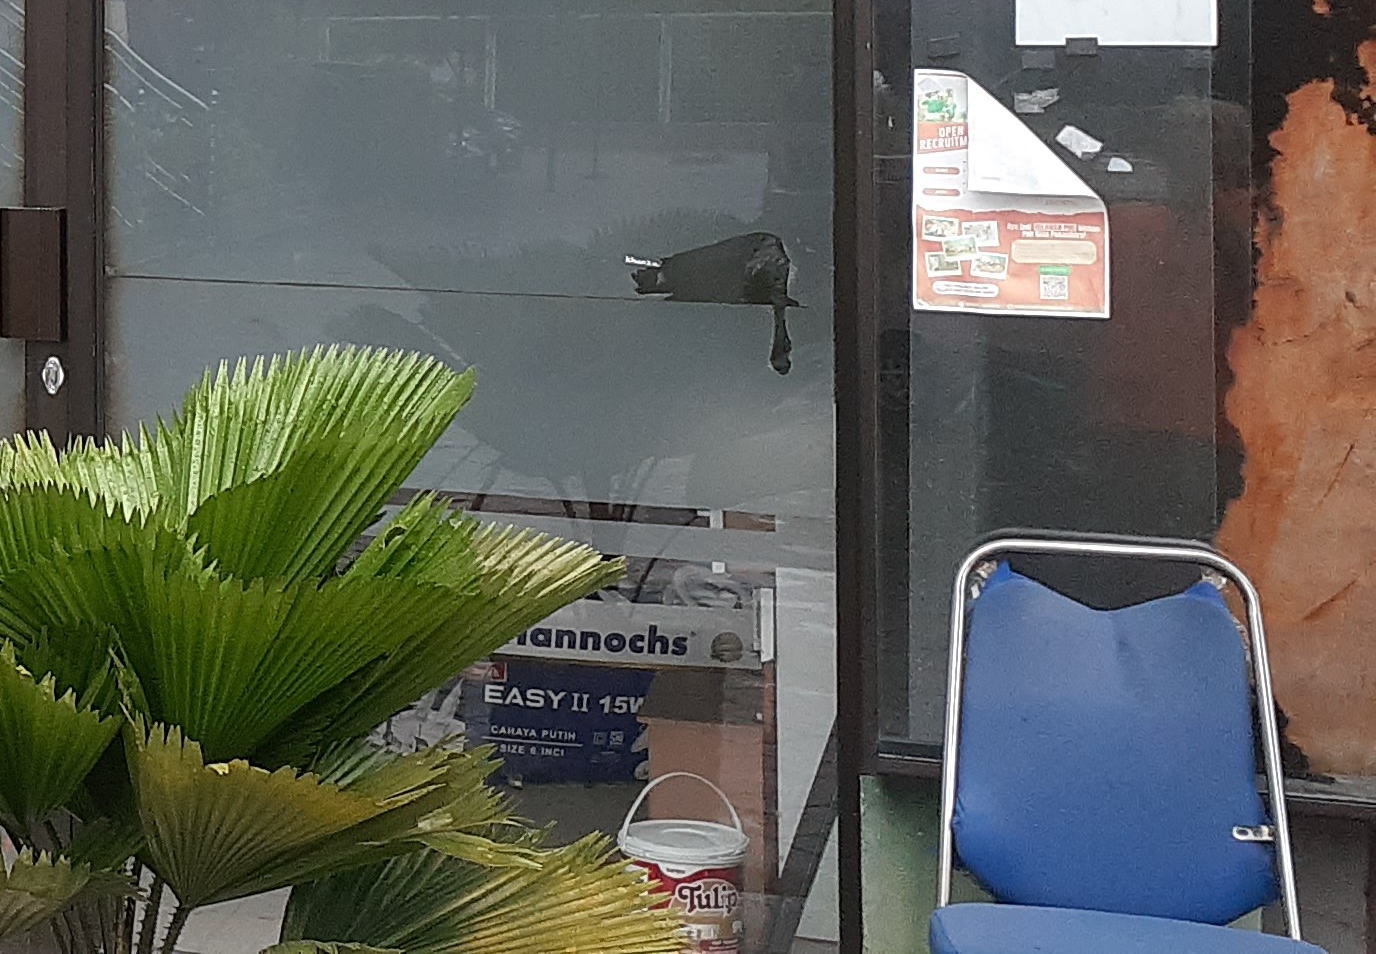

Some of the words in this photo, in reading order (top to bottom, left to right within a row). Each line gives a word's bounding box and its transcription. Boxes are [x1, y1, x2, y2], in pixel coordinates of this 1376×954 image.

[938, 126, 964, 138] OPEN
[484, 684, 566, 710] EASY
[491, 725, 537, 738] CAHAYA
[541, 729, 577, 741] PUTIH
[499, 744, 525, 755] SIZE
[678, 884, 738, 914] Tulip
